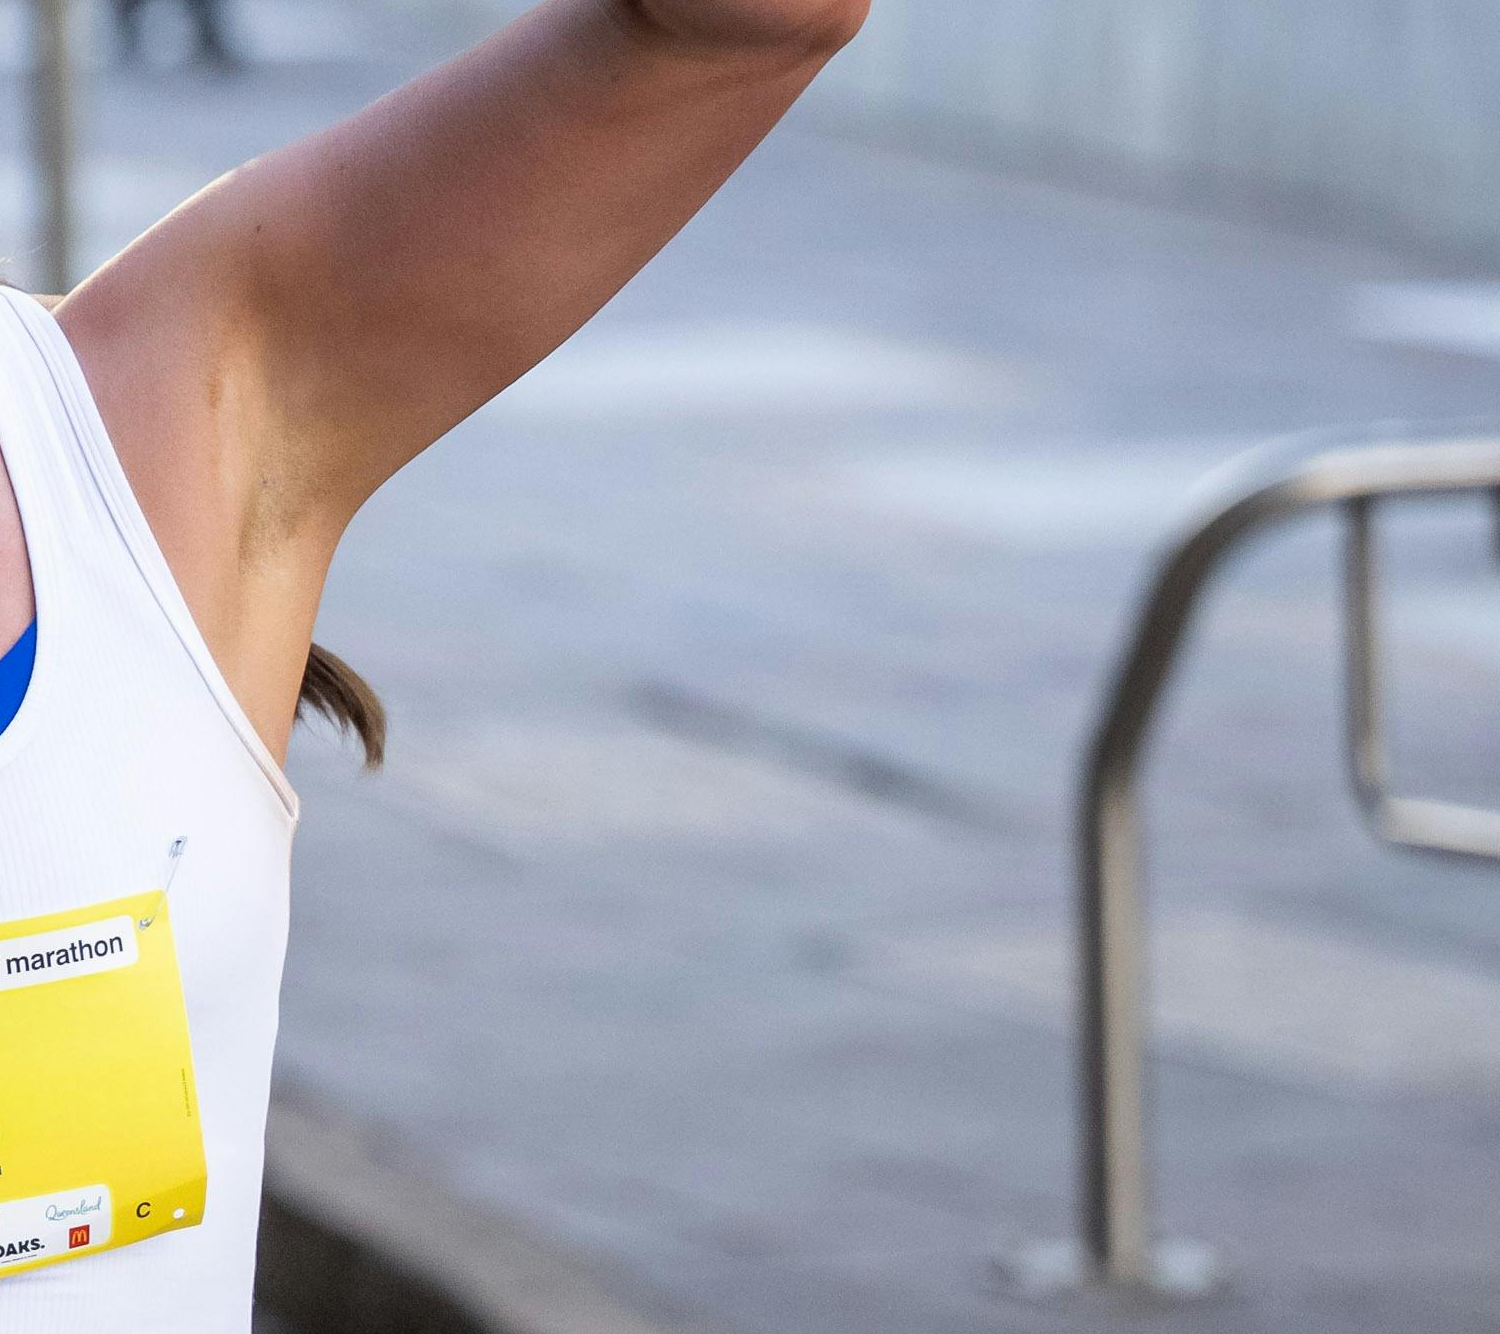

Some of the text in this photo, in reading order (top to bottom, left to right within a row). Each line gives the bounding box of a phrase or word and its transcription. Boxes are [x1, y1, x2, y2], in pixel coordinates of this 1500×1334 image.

[6, 935, 123, 975] marathon
[45, 1196, 101, 1220] Queensland
[136, 1202, 151, 1218] C
